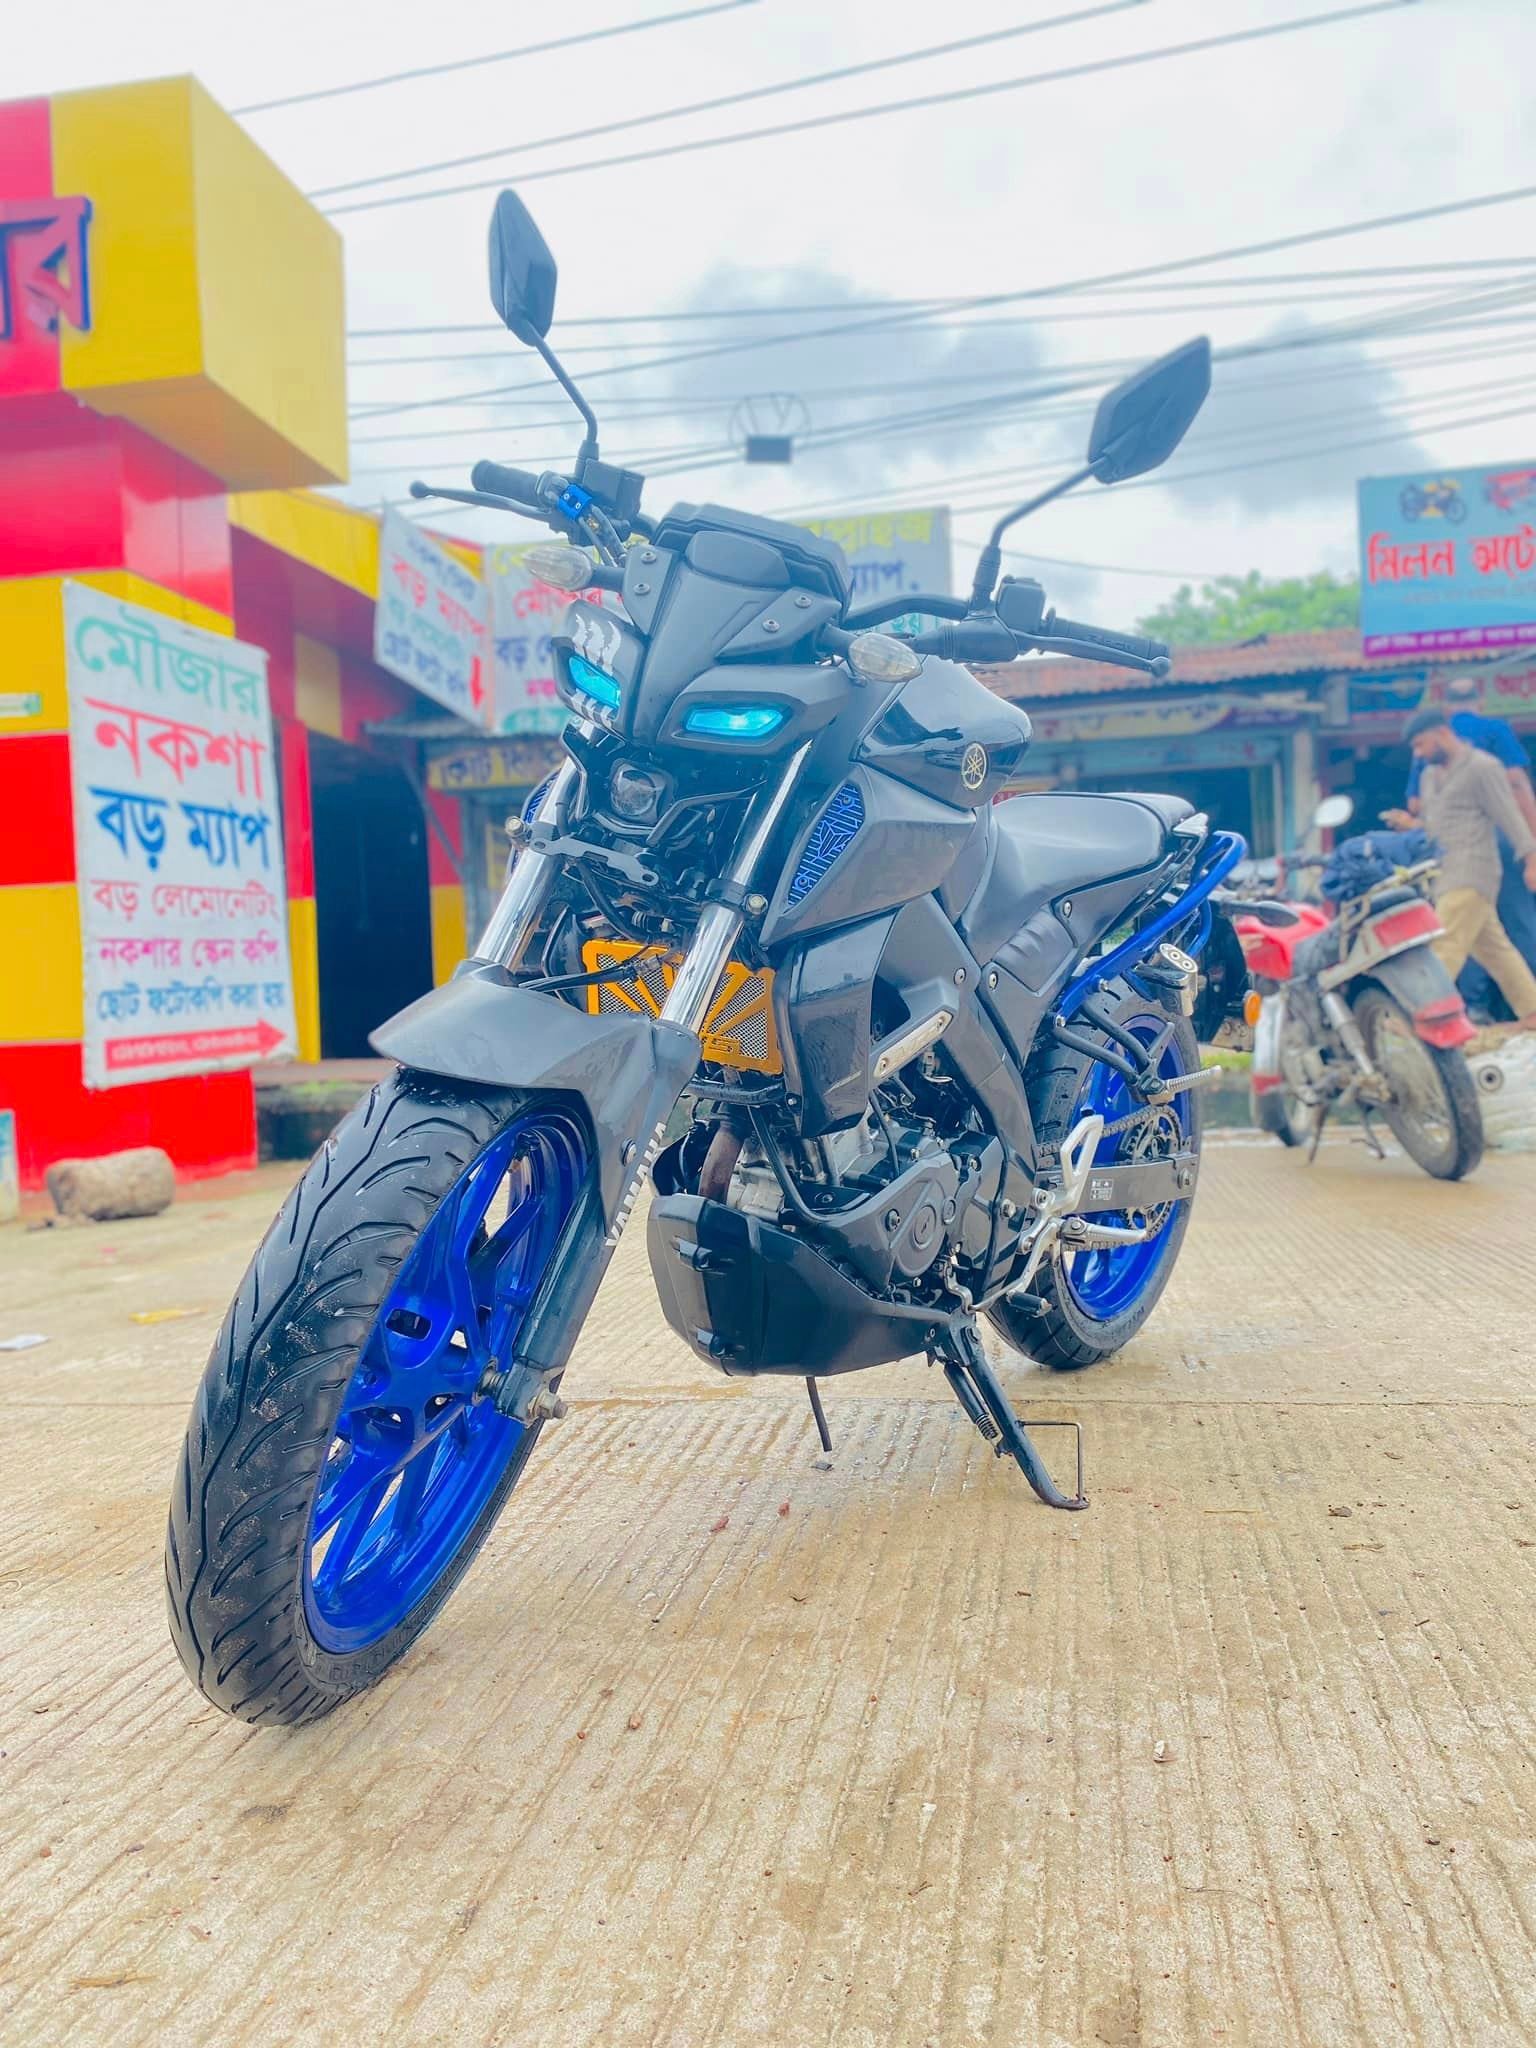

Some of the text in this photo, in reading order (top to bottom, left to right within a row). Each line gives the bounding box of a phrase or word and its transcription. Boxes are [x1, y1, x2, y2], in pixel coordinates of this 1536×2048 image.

[1366, 531, 1456, 585] মিলন
[75, 605, 262, 718] মৌজার
[84, 696, 267, 800] নকশা
[87, 784, 272, 871] বড় ম্যাপ
[90, 879, 140, 922] বড়
[97, 937, 182, 971] নকশার
[242, 928, 279, 967] কপি
